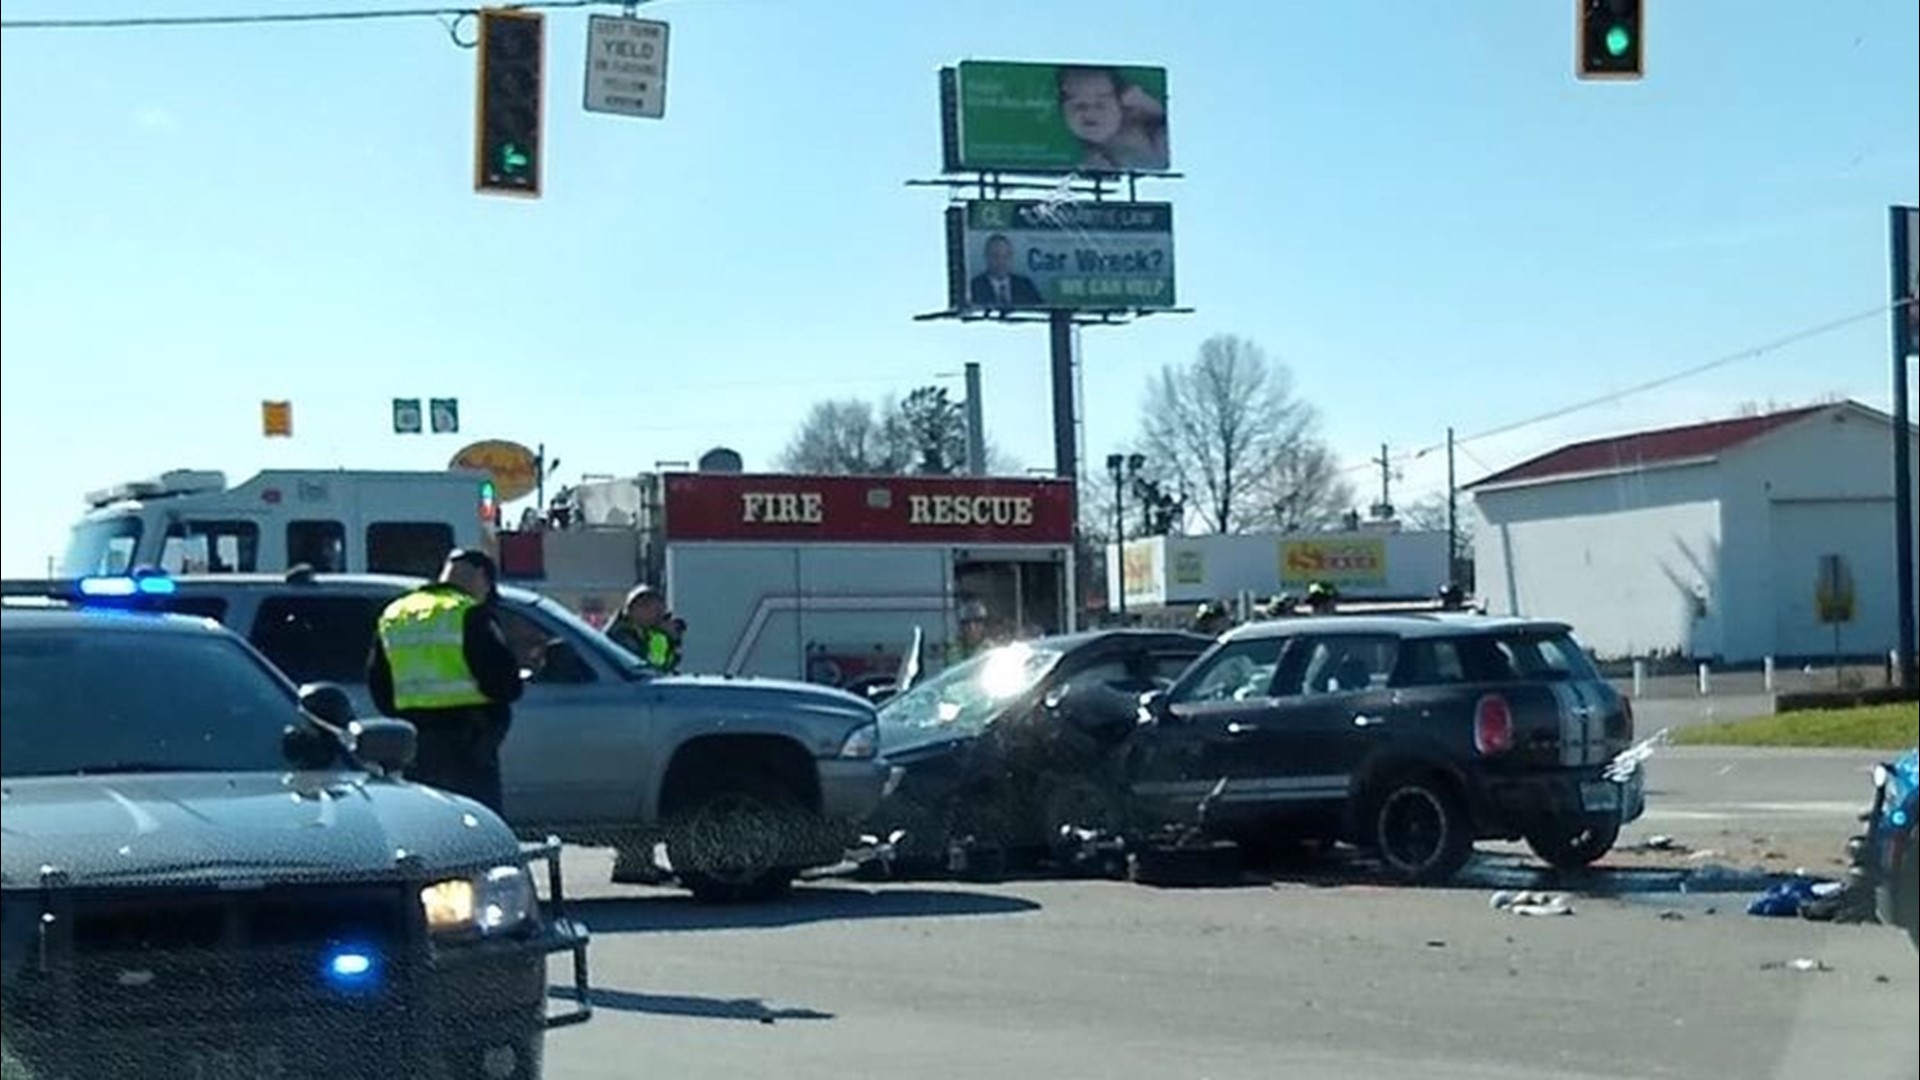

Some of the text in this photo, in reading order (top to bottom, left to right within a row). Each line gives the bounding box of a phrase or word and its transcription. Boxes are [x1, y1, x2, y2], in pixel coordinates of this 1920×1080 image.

[603, 39, 655, 60] YIELD
[1027, 247, 1164, 273] Car Wreck?
[1060, 279, 1085, 296] WE
[1087, 279, 1122, 296] CAN
[742, 492, 1033, 525] FIRE RESCUE
